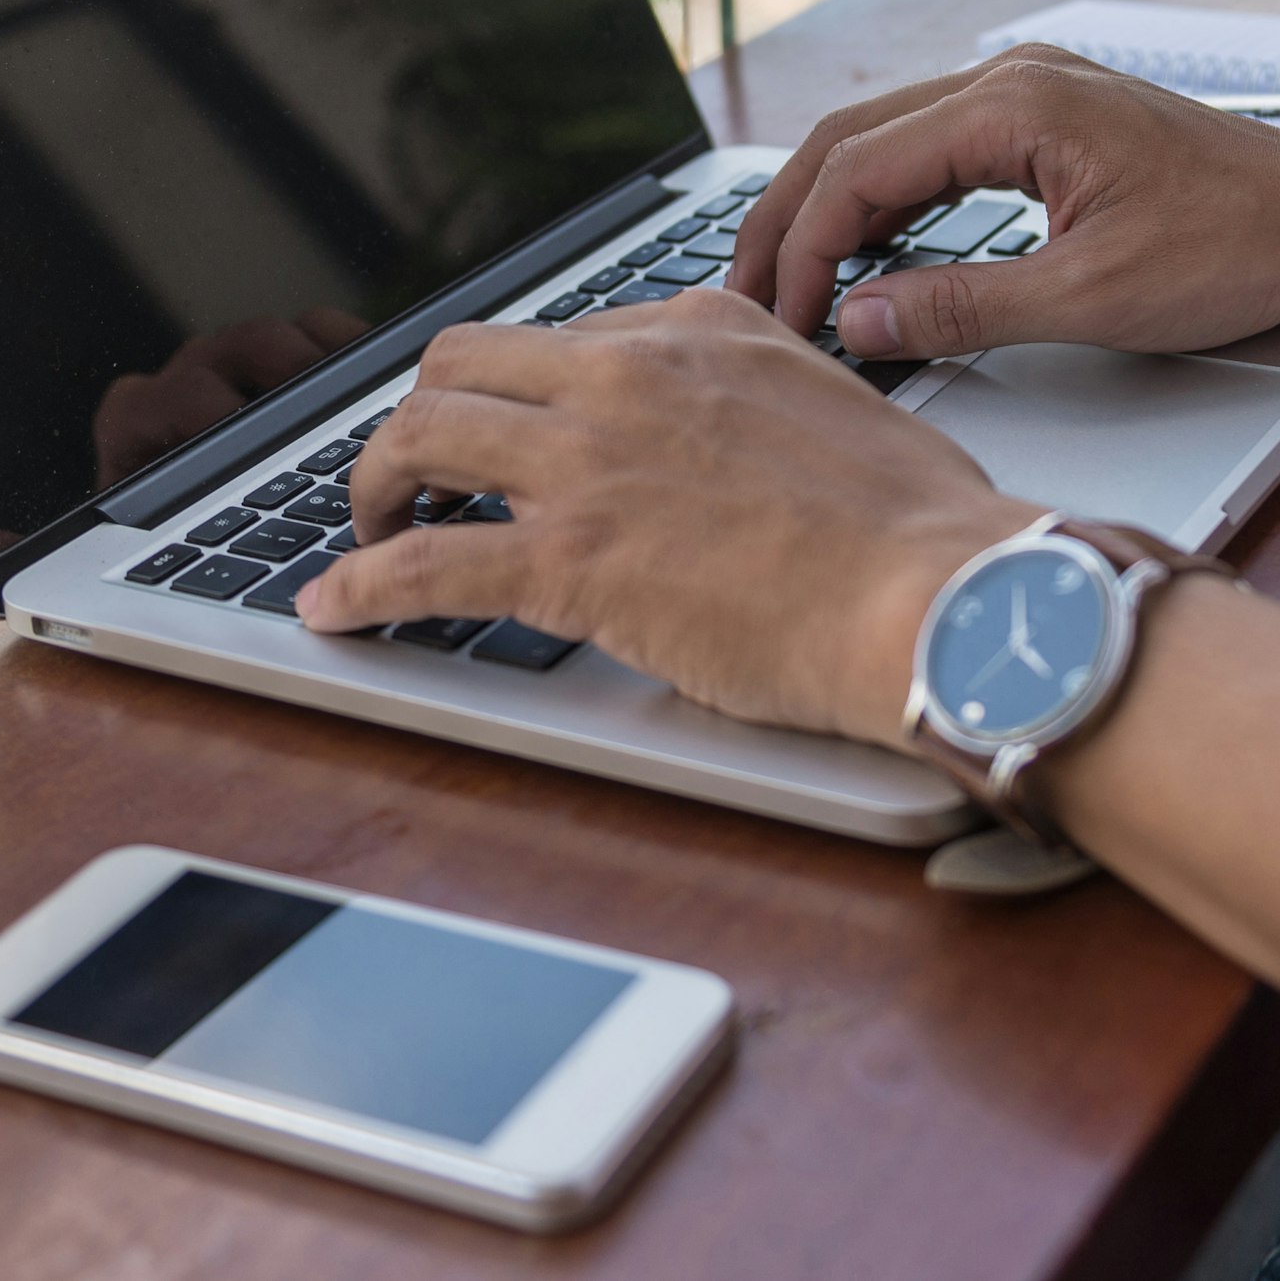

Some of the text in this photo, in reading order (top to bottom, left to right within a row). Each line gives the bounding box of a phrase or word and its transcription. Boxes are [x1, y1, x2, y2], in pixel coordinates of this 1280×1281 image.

[294, 475, 307, 483] F2
[332, 501, 351, 509] 2
[152, 552, 175, 567] esc
